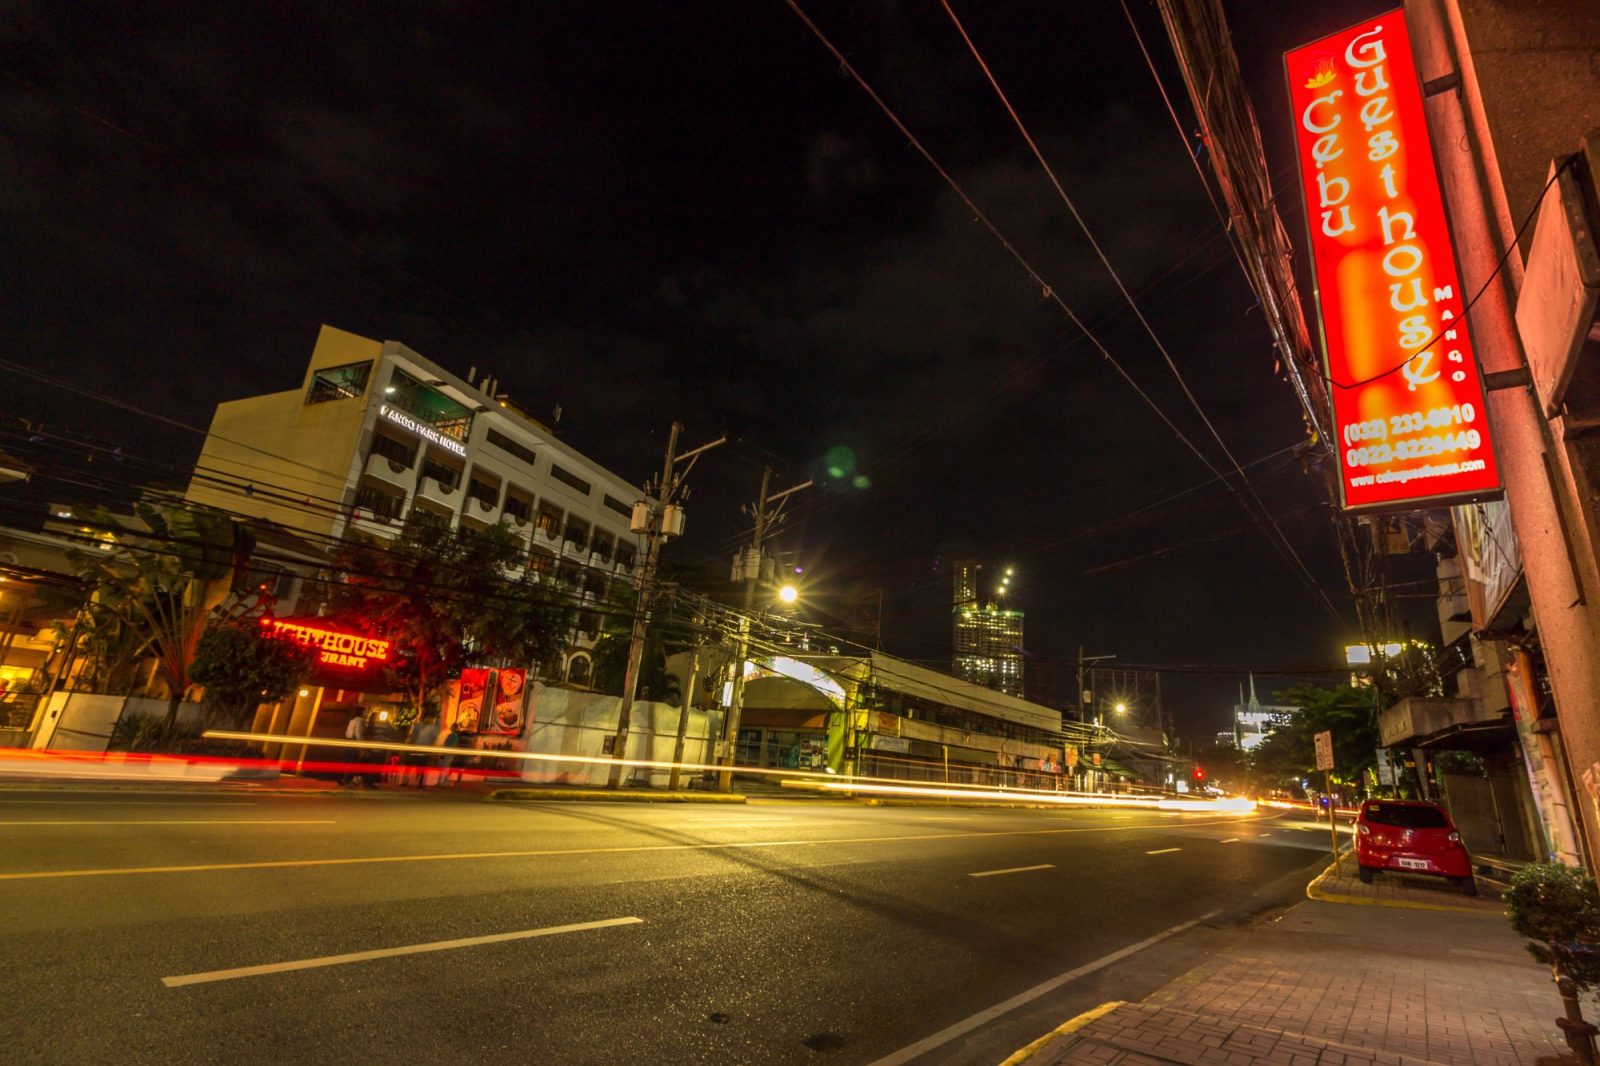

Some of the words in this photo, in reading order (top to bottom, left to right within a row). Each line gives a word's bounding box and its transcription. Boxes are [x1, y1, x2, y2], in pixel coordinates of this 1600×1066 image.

[1302, 90, 1355, 237] Cebu
[416, 424, 440, 442] PARK
[440, 437, 467, 457] HOTEL
